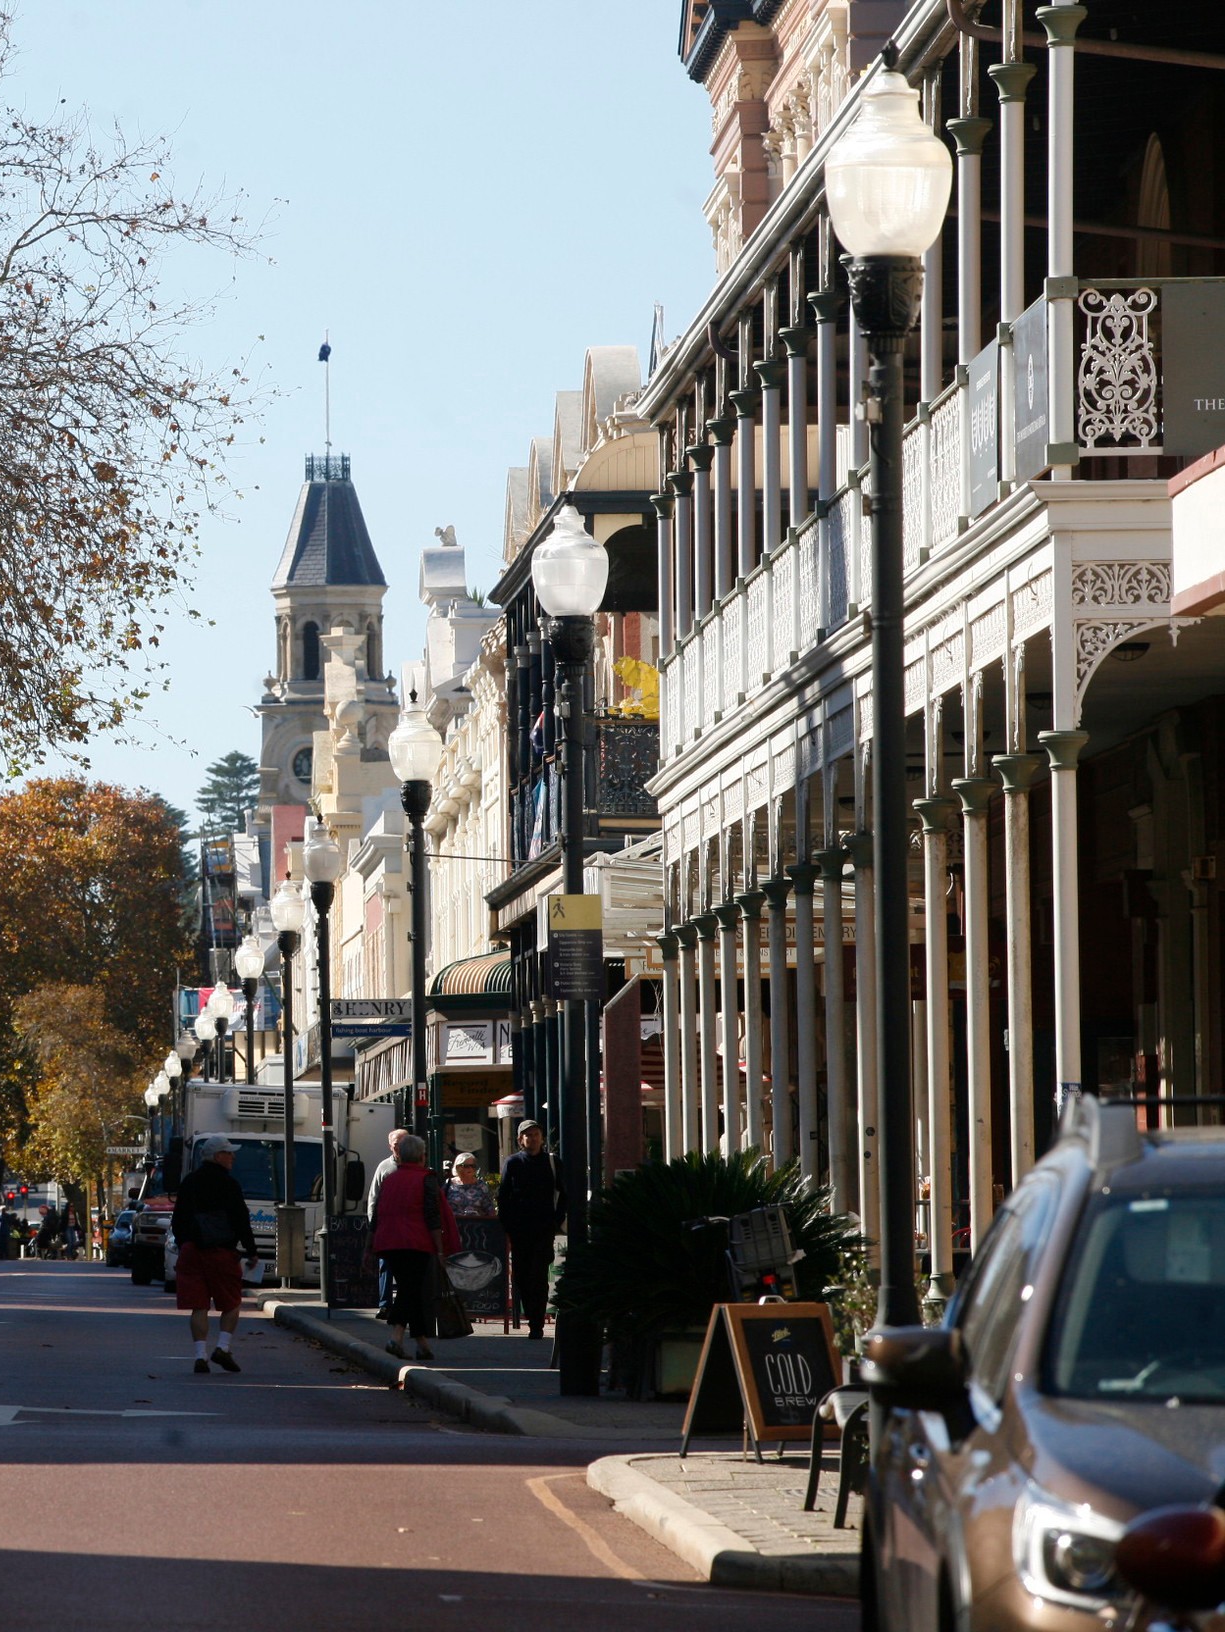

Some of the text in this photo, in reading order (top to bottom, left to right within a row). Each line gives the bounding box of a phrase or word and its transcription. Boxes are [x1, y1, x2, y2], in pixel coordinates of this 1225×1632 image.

[1193, 398, 1225, 411] THE
[419, 1090, 426, 1100] H
[765, 1353, 812, 1395] COLD
[774, 1396, 817, 1407] BREW
